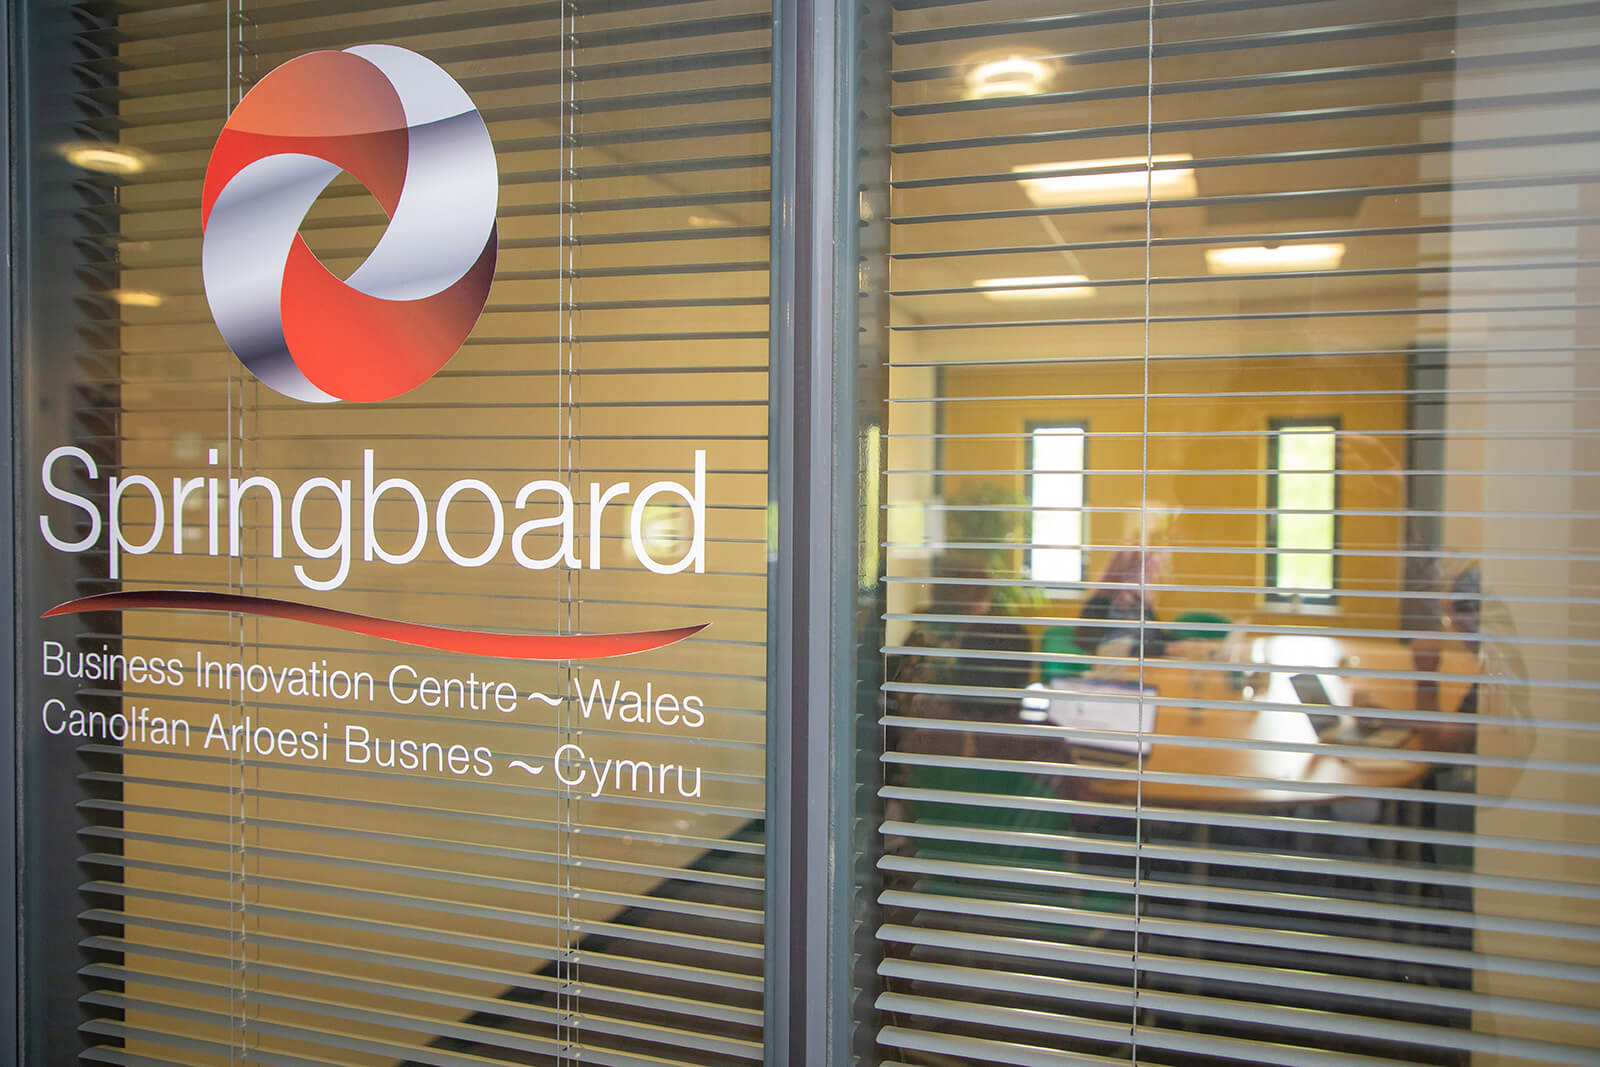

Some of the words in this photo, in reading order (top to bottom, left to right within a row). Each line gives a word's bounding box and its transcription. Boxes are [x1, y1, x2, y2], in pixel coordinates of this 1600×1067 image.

[39, 446, 707, 591] Springboard
[42, 640, 184, 687] Business
[196, 651, 375, 701] Innovation
[388, 664, 518, 713] Centre
[573, 677, 705, 728] Wales
[42, 698, 190, 747] Canolfan
[203, 713, 329, 761] Arloesi
[345, 725, 493, 777] Busnes
[553, 743, 702, 799] Cymru
